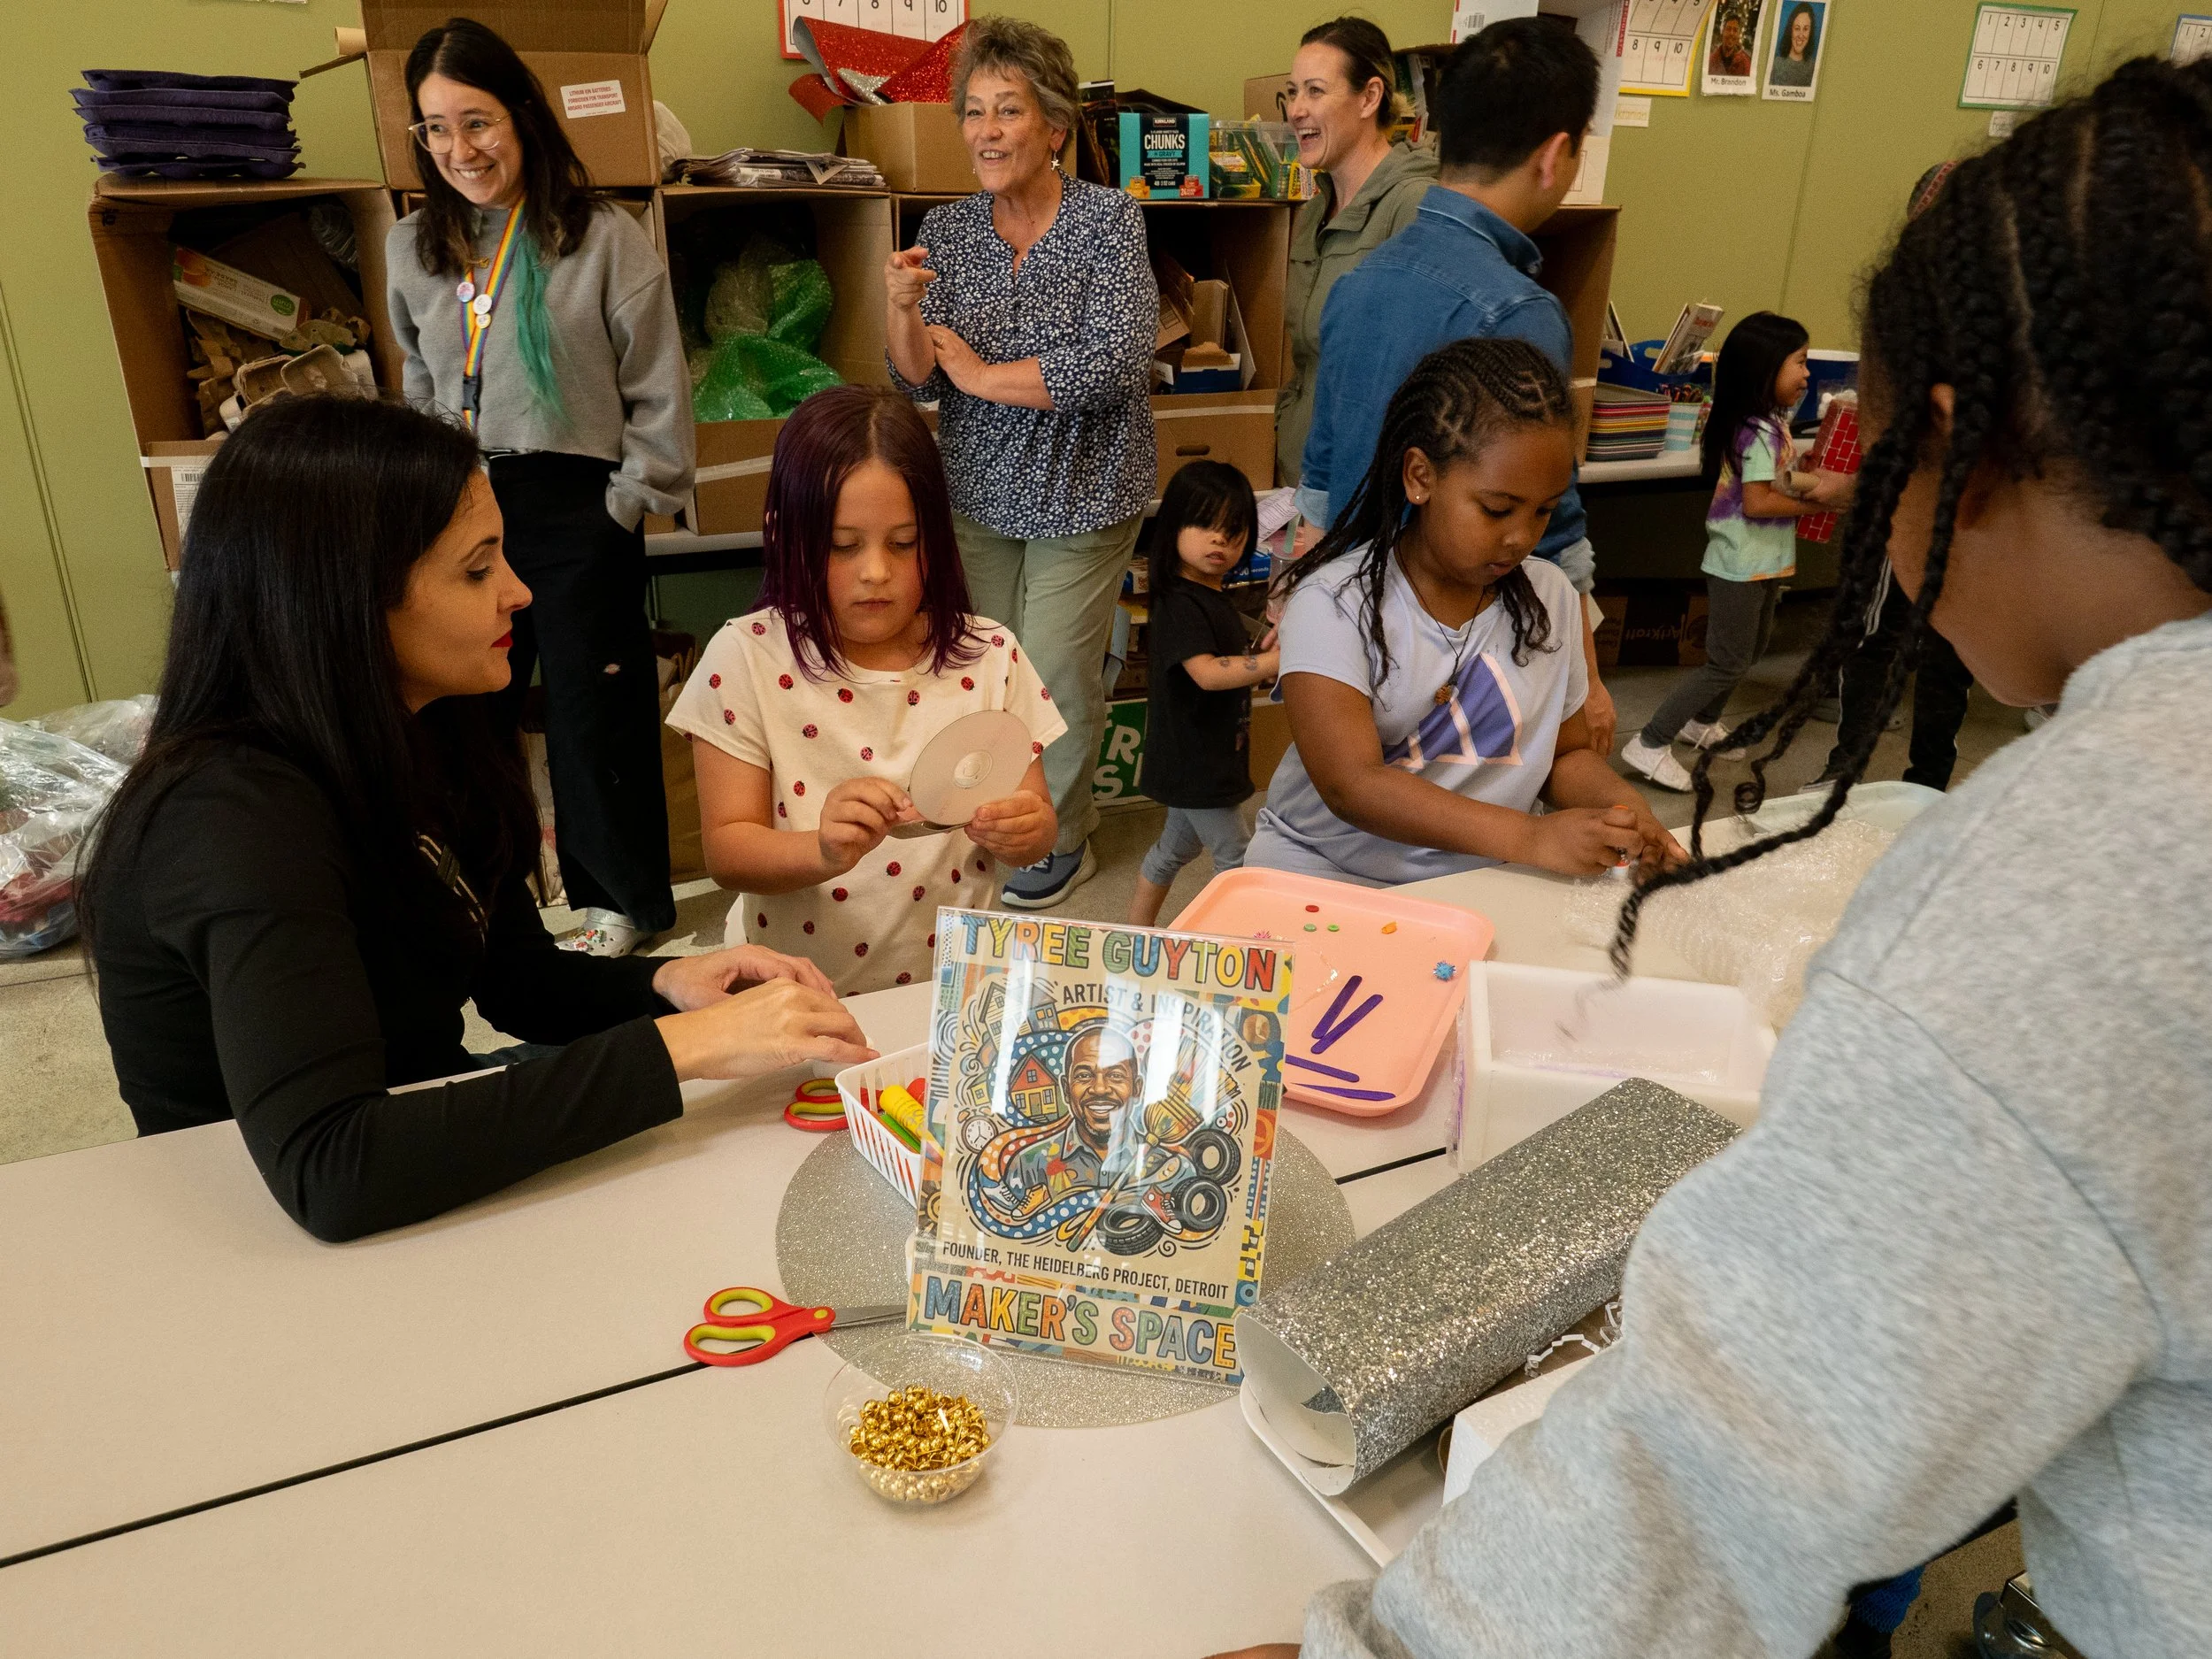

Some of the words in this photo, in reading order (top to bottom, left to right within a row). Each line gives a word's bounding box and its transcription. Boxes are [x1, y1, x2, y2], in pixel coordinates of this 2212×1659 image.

[904, 0, 912, 12] 9
[934, 0, 948, 13] 10
[2004, 16, 2010, 27] 2
[2020, 18, 2026, 28] 3
[2038, 19, 2044, 29] 4
[2054, 20, 2061, 31] 5
[2200, 27, 2206, 38] 2
[1632, 39, 1639, 50] 8
[1654, 41, 1661, 52] 9
[1673, 42, 1683, 54] 10
[1978, 59, 1984, 70] 6
[1994, 60, 2001, 71] 7
[2010, 62, 2016, 72] 8
[2028, 63, 2034, 73] 9
[2042, 64, 2051, 74] 10
[1710, 77, 1720, 86] Mr.
[1781, 89, 1806, 98] Gamboa
[1144, 134, 1186, 150] CHUNKS
[961, 914, 1092, 969] TYREE
[1102, 930, 1276, 992] GUYTON
[1063, 982, 1127, 1005] ARTIST
[1131, 992, 1143, 1013] &
[942, 1241, 1002, 1266] FOUNDER,
[1007, 1251, 1030, 1268] THE
[1033, 1256, 1110, 1281] HEIDELBERG
[1113, 1268, 1171, 1293] PROJECT,
[1175, 1278, 1229, 1300] DETROIT
[924, 1275, 1100, 1346] MAKER'S
[1109, 1306, 1236, 1370] SPACE
